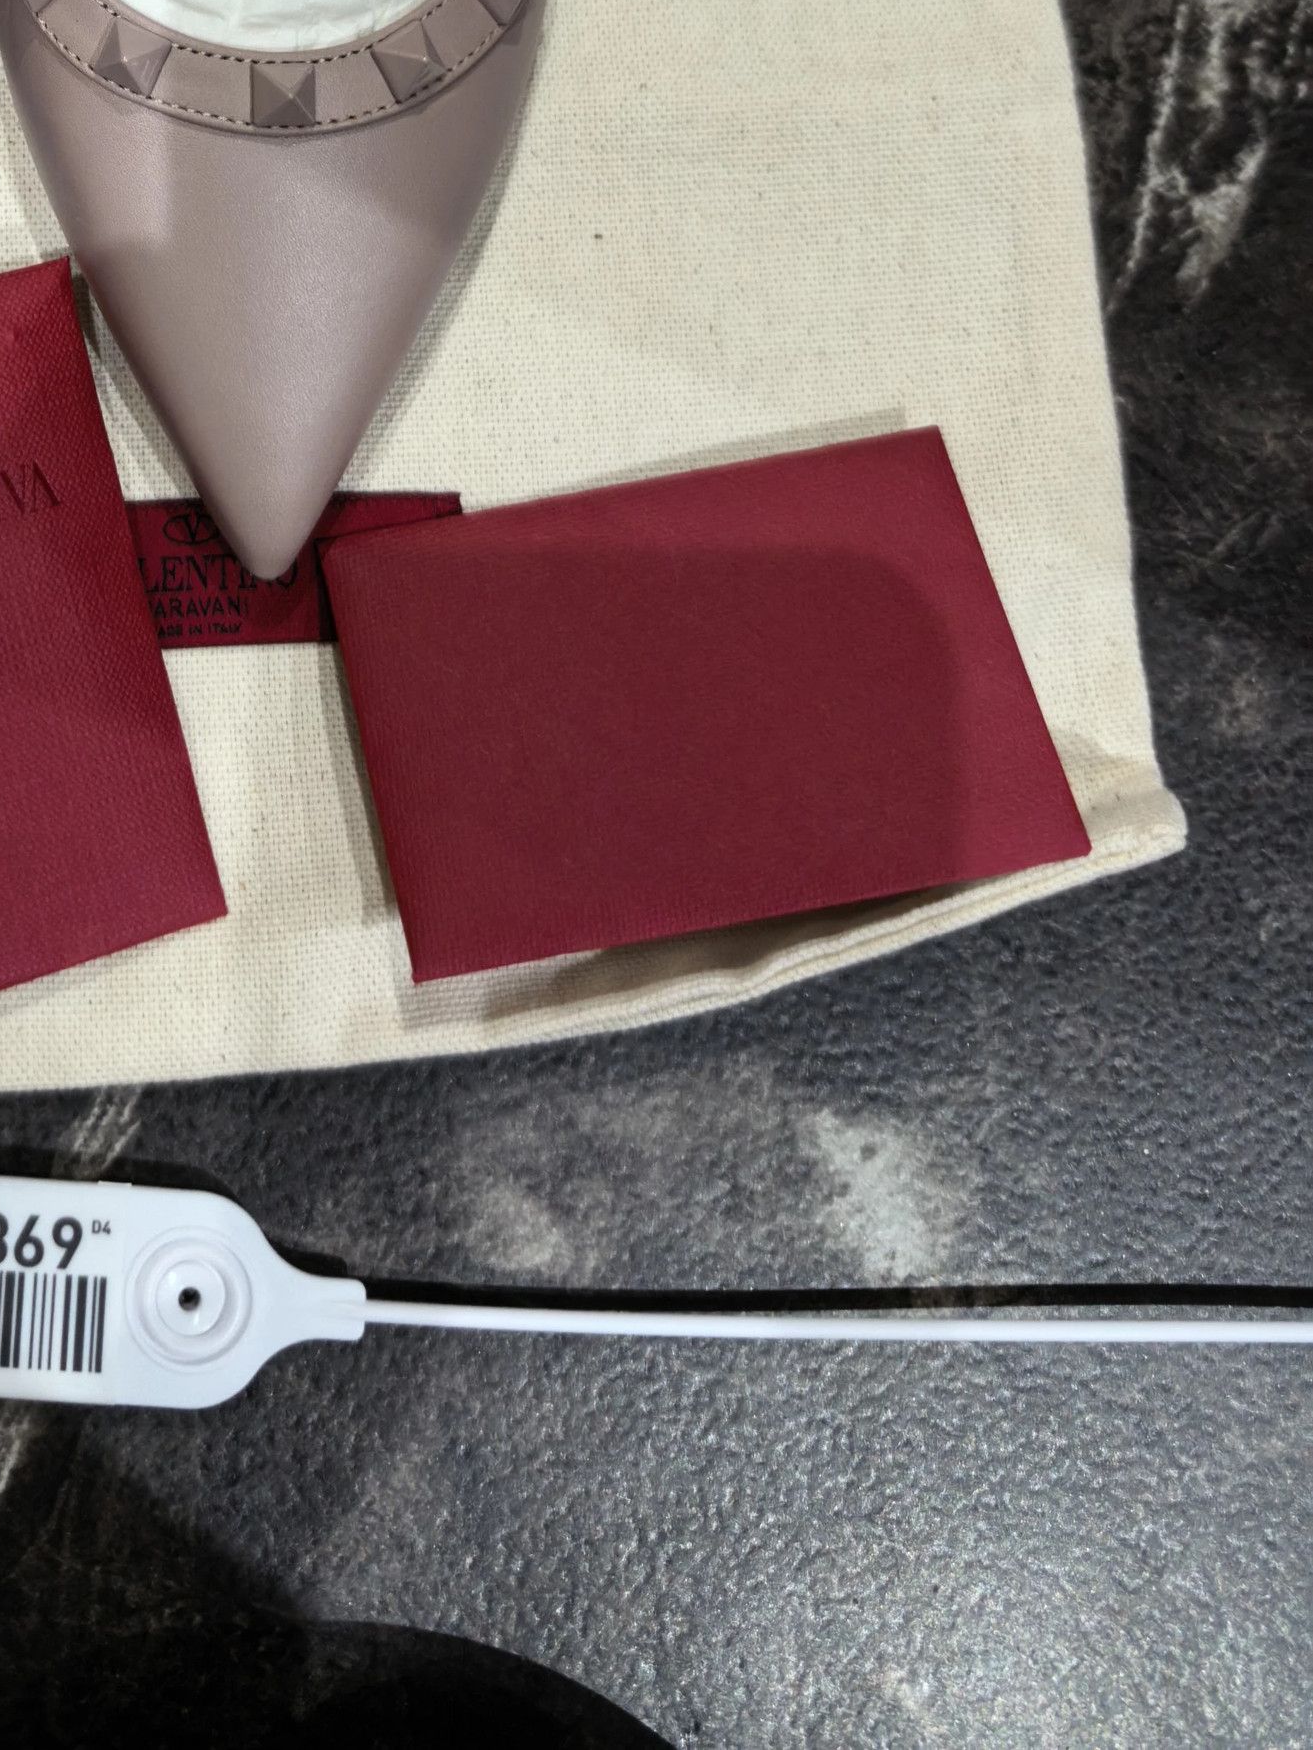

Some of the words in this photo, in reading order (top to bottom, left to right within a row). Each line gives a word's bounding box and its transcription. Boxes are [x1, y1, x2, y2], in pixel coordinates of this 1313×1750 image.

[153, 596, 249, 619] ARAVANI
[157, 623, 183, 639] ADE
[91, 1219, 112, 1235] D4
